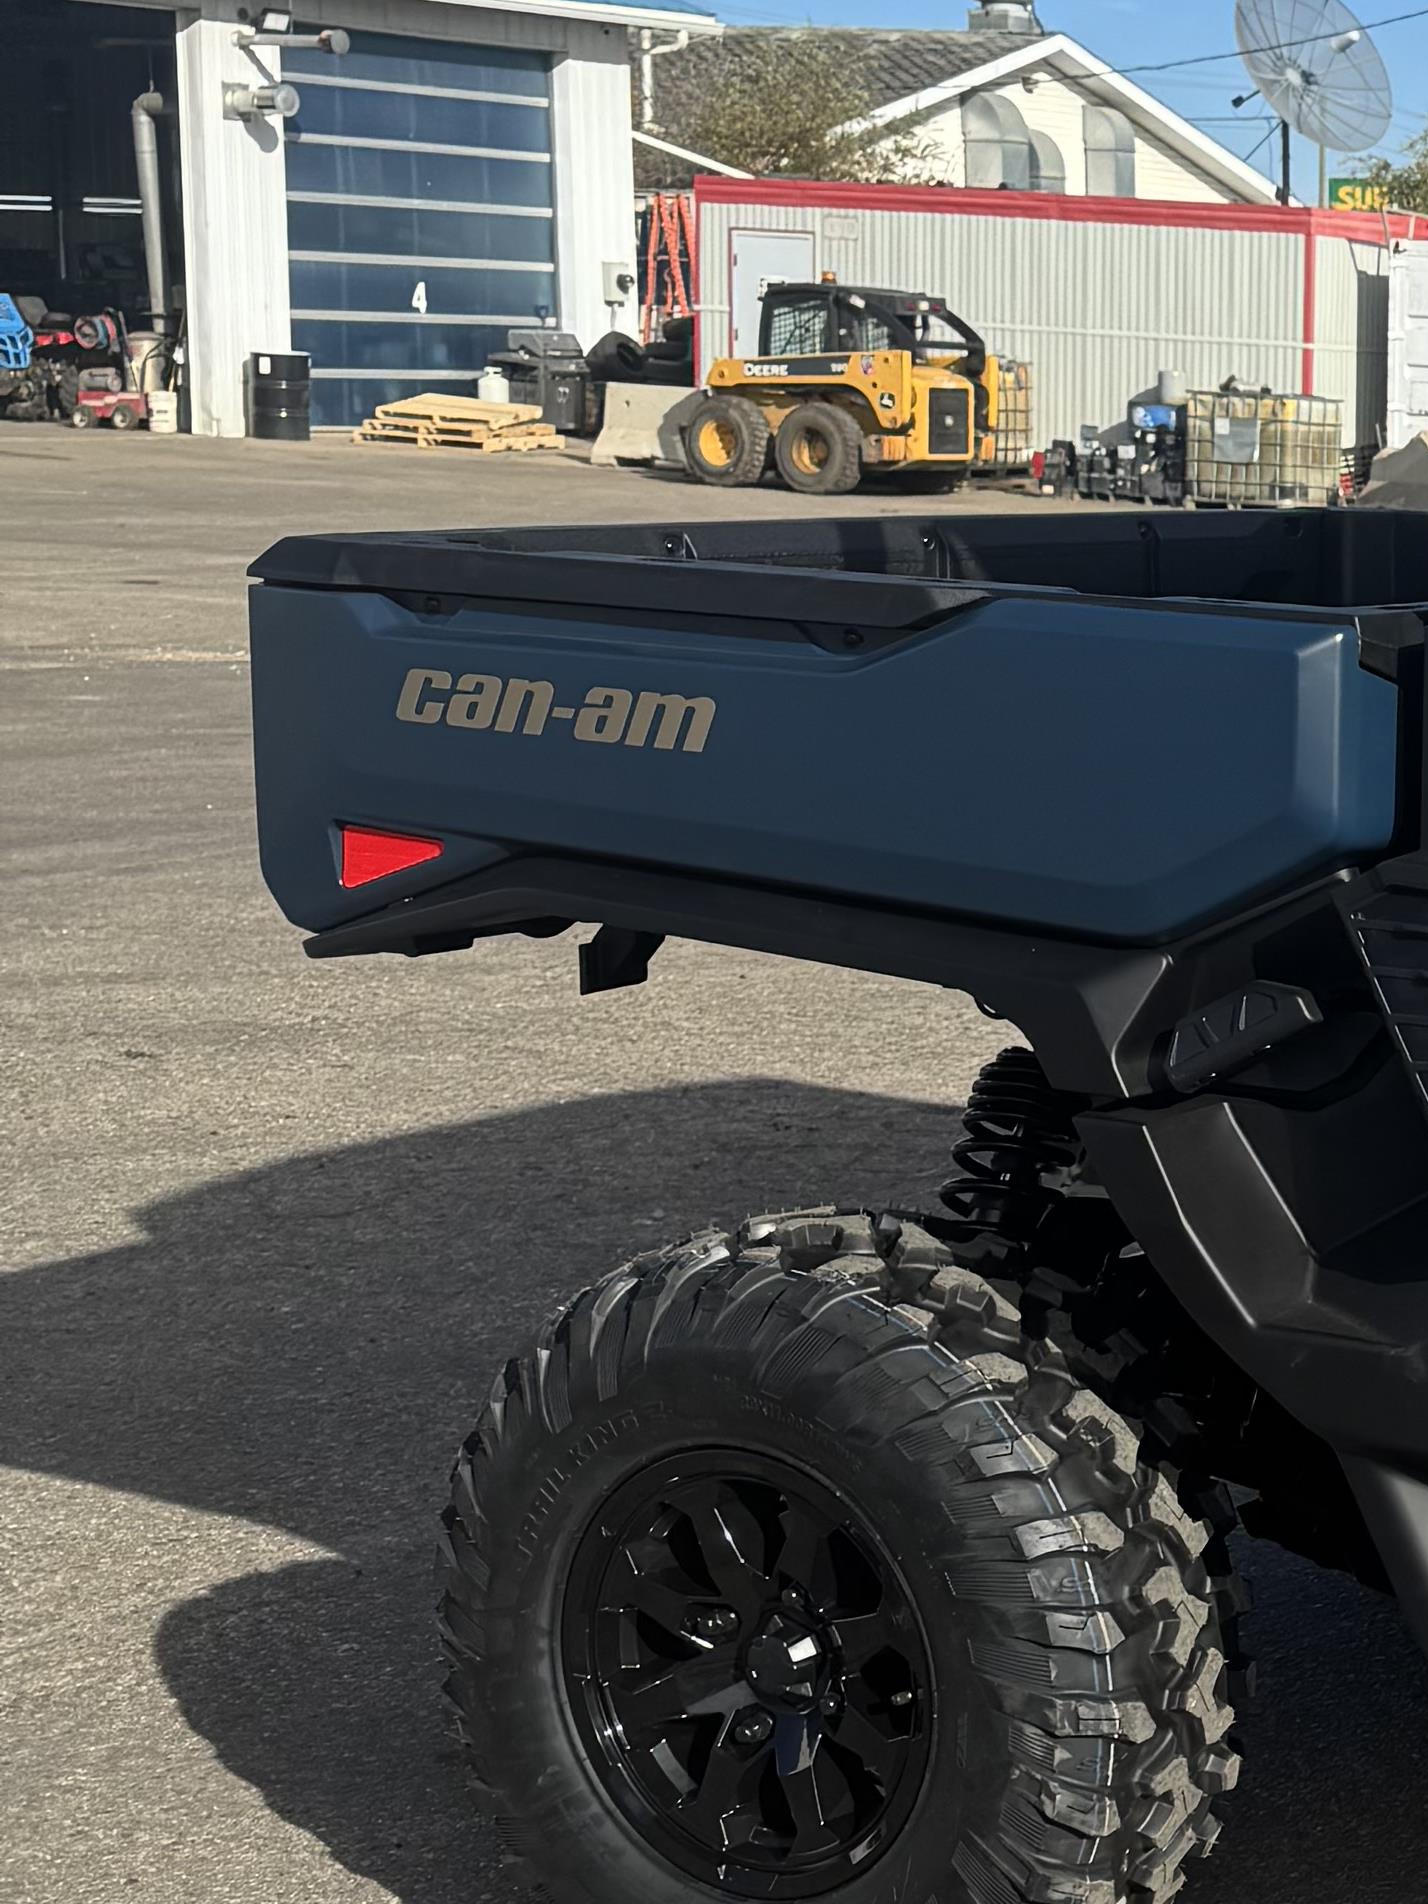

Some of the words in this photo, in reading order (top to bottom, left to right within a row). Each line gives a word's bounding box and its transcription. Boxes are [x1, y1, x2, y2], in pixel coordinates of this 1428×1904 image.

[411, 281, 427, 314] 4
[743, 362, 789, 377] DEERE
[395, 667, 717, 754] can-am
